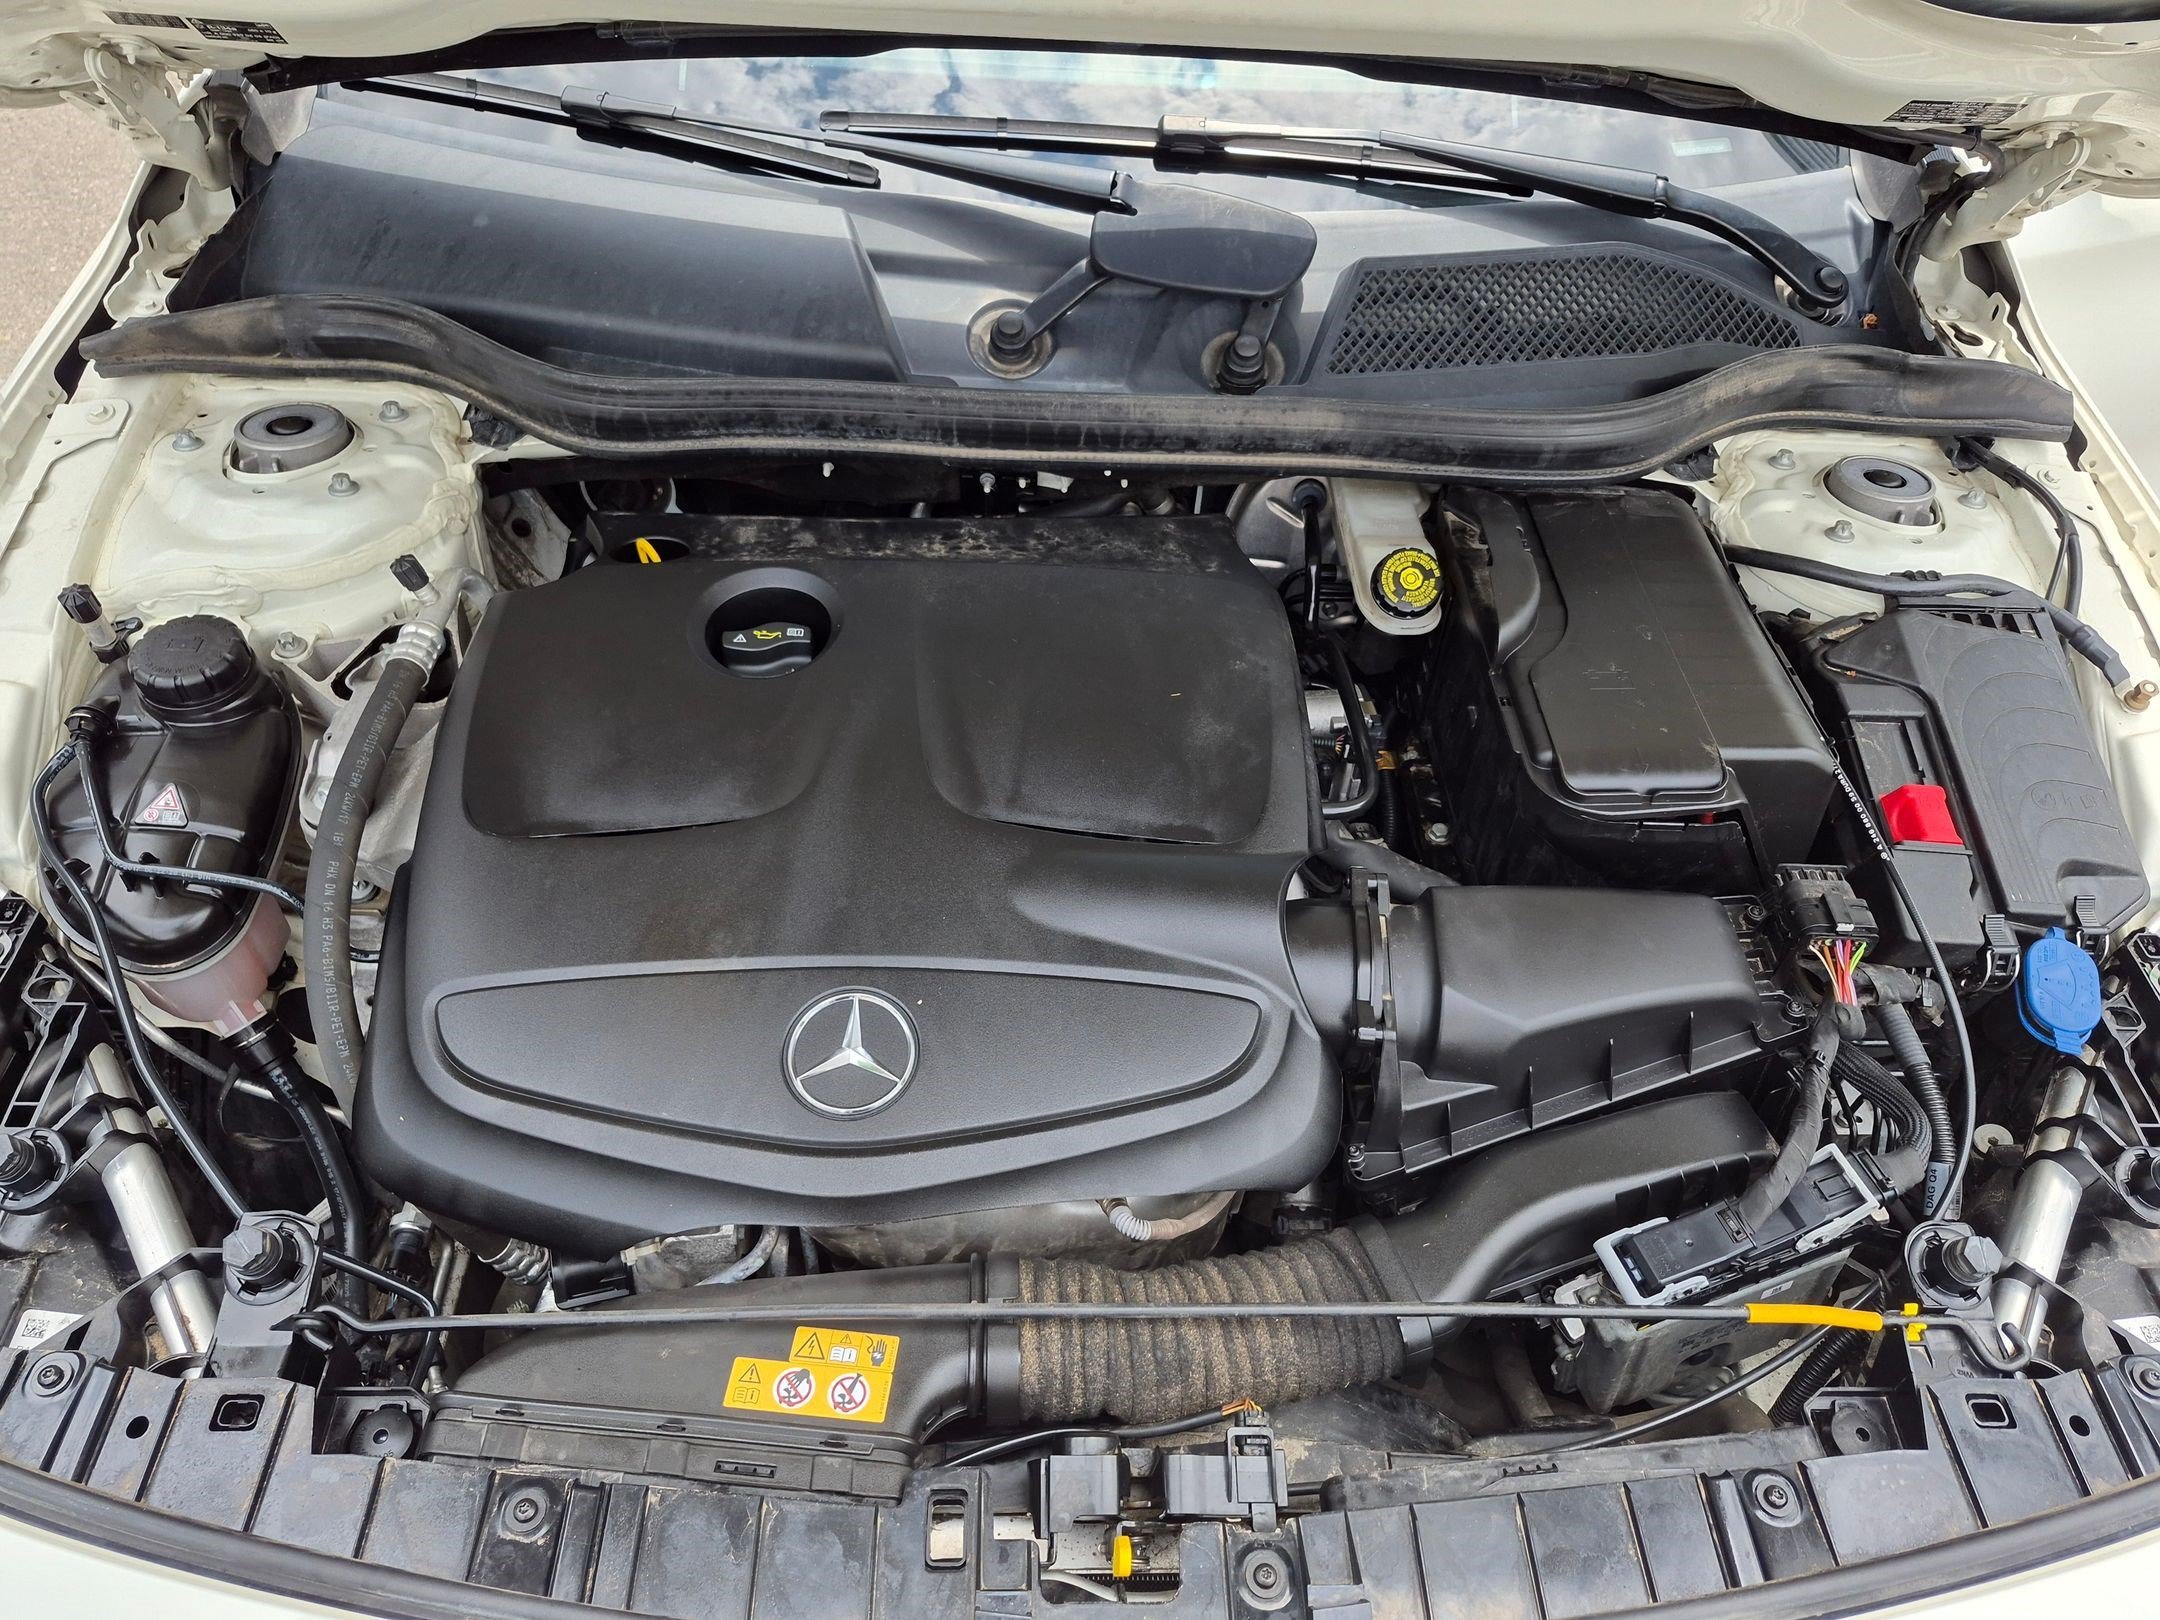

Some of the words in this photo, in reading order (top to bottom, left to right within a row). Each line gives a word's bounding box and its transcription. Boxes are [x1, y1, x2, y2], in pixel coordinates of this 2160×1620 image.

[1837, 774, 1852, 793] DURA
[1854, 802, 1863, 813] 00
[326, 860, 339, 879] PHX
[324, 883, 336, 896] DN
[323, 901, 335, 913] 16
[1928, 1168, 1937, 1183] Q4
[1925, 1186, 1936, 1209] DAG
